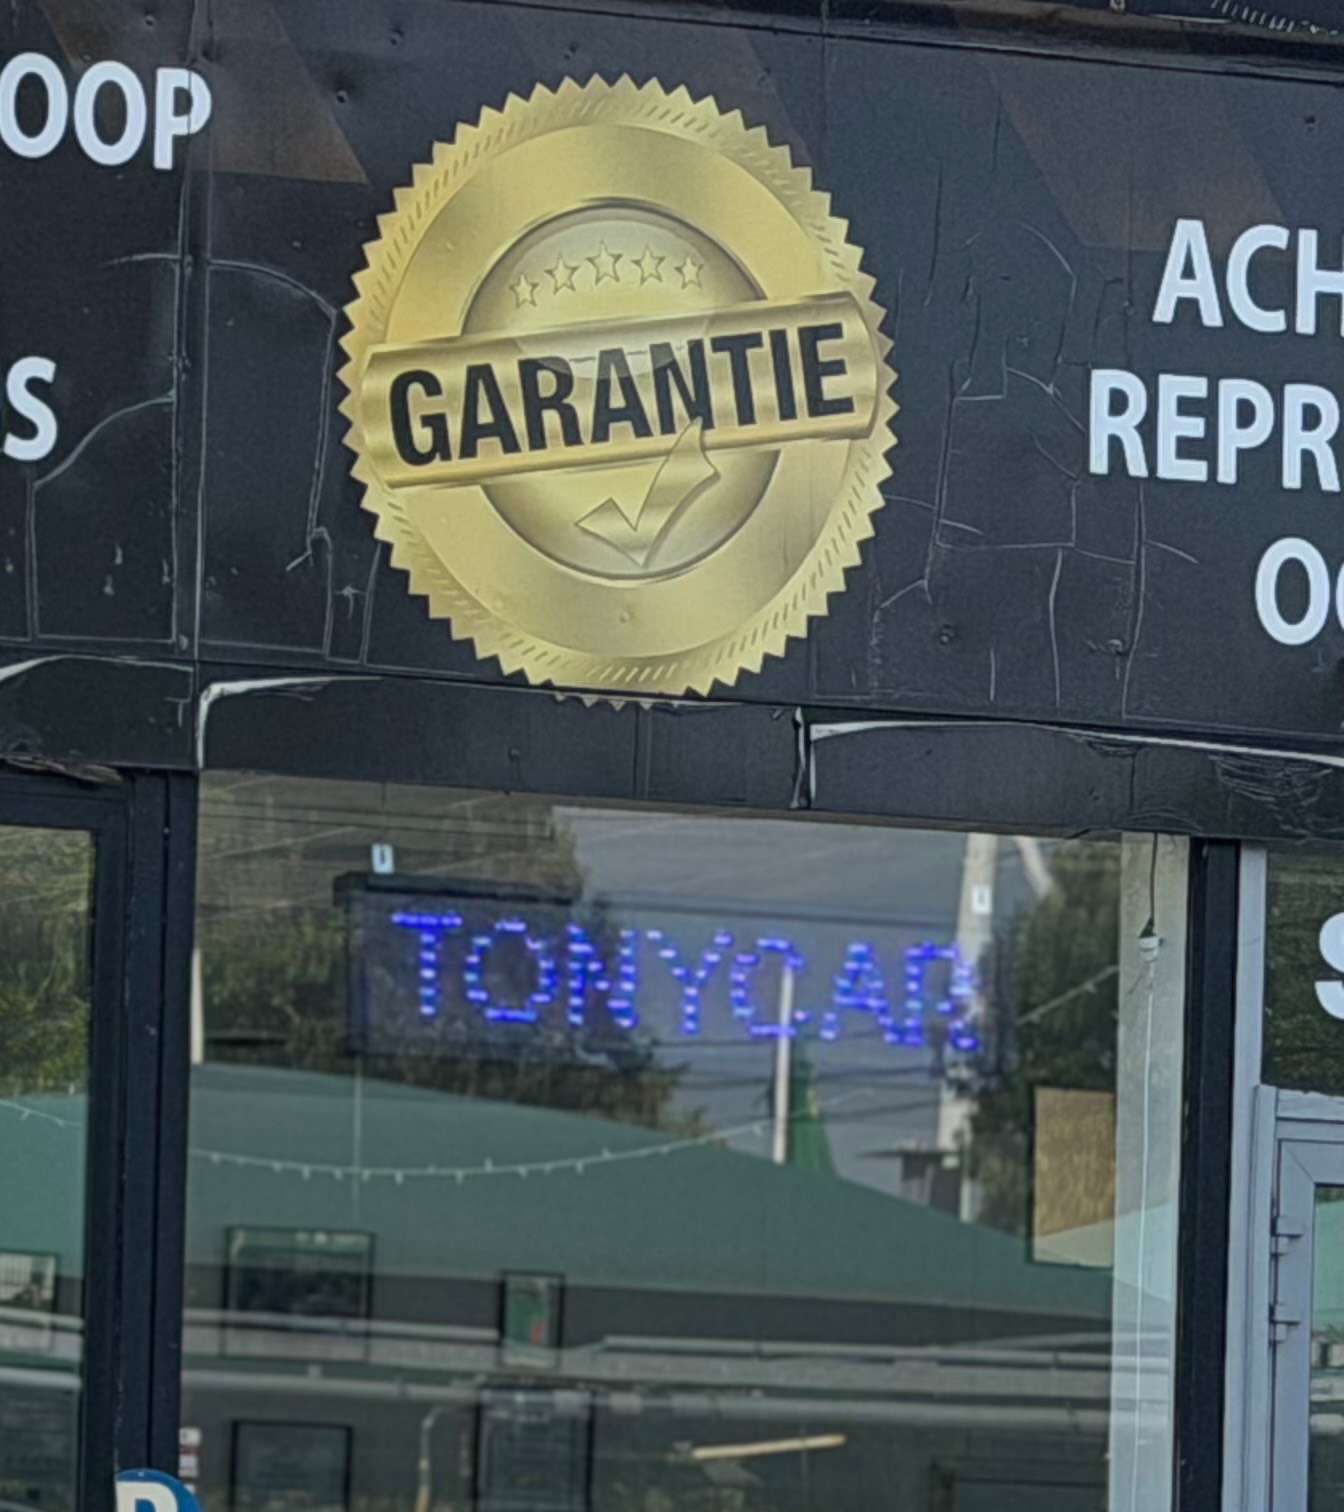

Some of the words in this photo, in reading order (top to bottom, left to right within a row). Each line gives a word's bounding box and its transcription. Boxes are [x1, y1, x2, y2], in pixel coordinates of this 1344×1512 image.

[388, 322, 856, 468] GARANTIE
[1089, 368, 1342, 493] REPR
[1255, 536, 1344, 646] O
